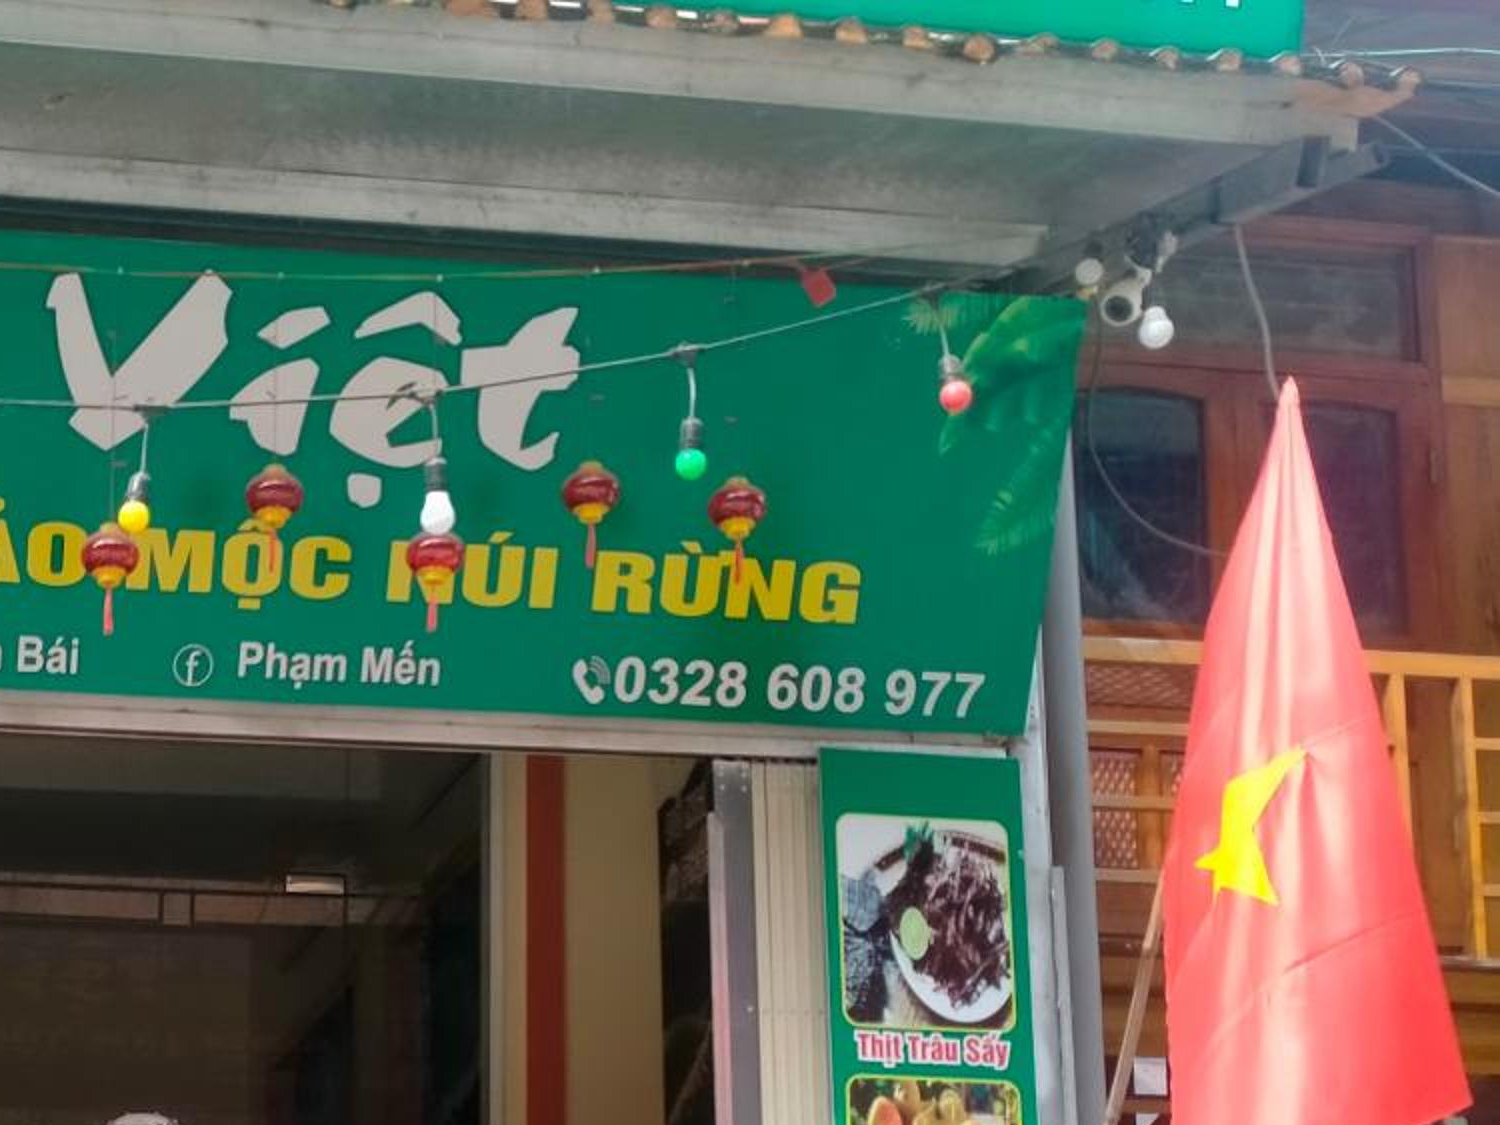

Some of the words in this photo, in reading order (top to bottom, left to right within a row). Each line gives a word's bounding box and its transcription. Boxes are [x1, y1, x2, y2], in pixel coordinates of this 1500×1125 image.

[45, 270, 581, 508] Việt
[125, 518, 352, 610] MỘC
[591, 540, 861, 625] RỪNG
[17, 635, 80, 675] Bái
[237, 641, 347, 690] Phạm
[360, 640, 441, 686] Mến
[614, 656, 748, 708] 0328
[766, 664, 866, 713] 608
[885, 669, 986, 718] 977
[855, 1030, 905, 1068] Thịt
[905, 1032, 961, 1065] Trâu
[964, 1030, 1011, 1070] Sấy
